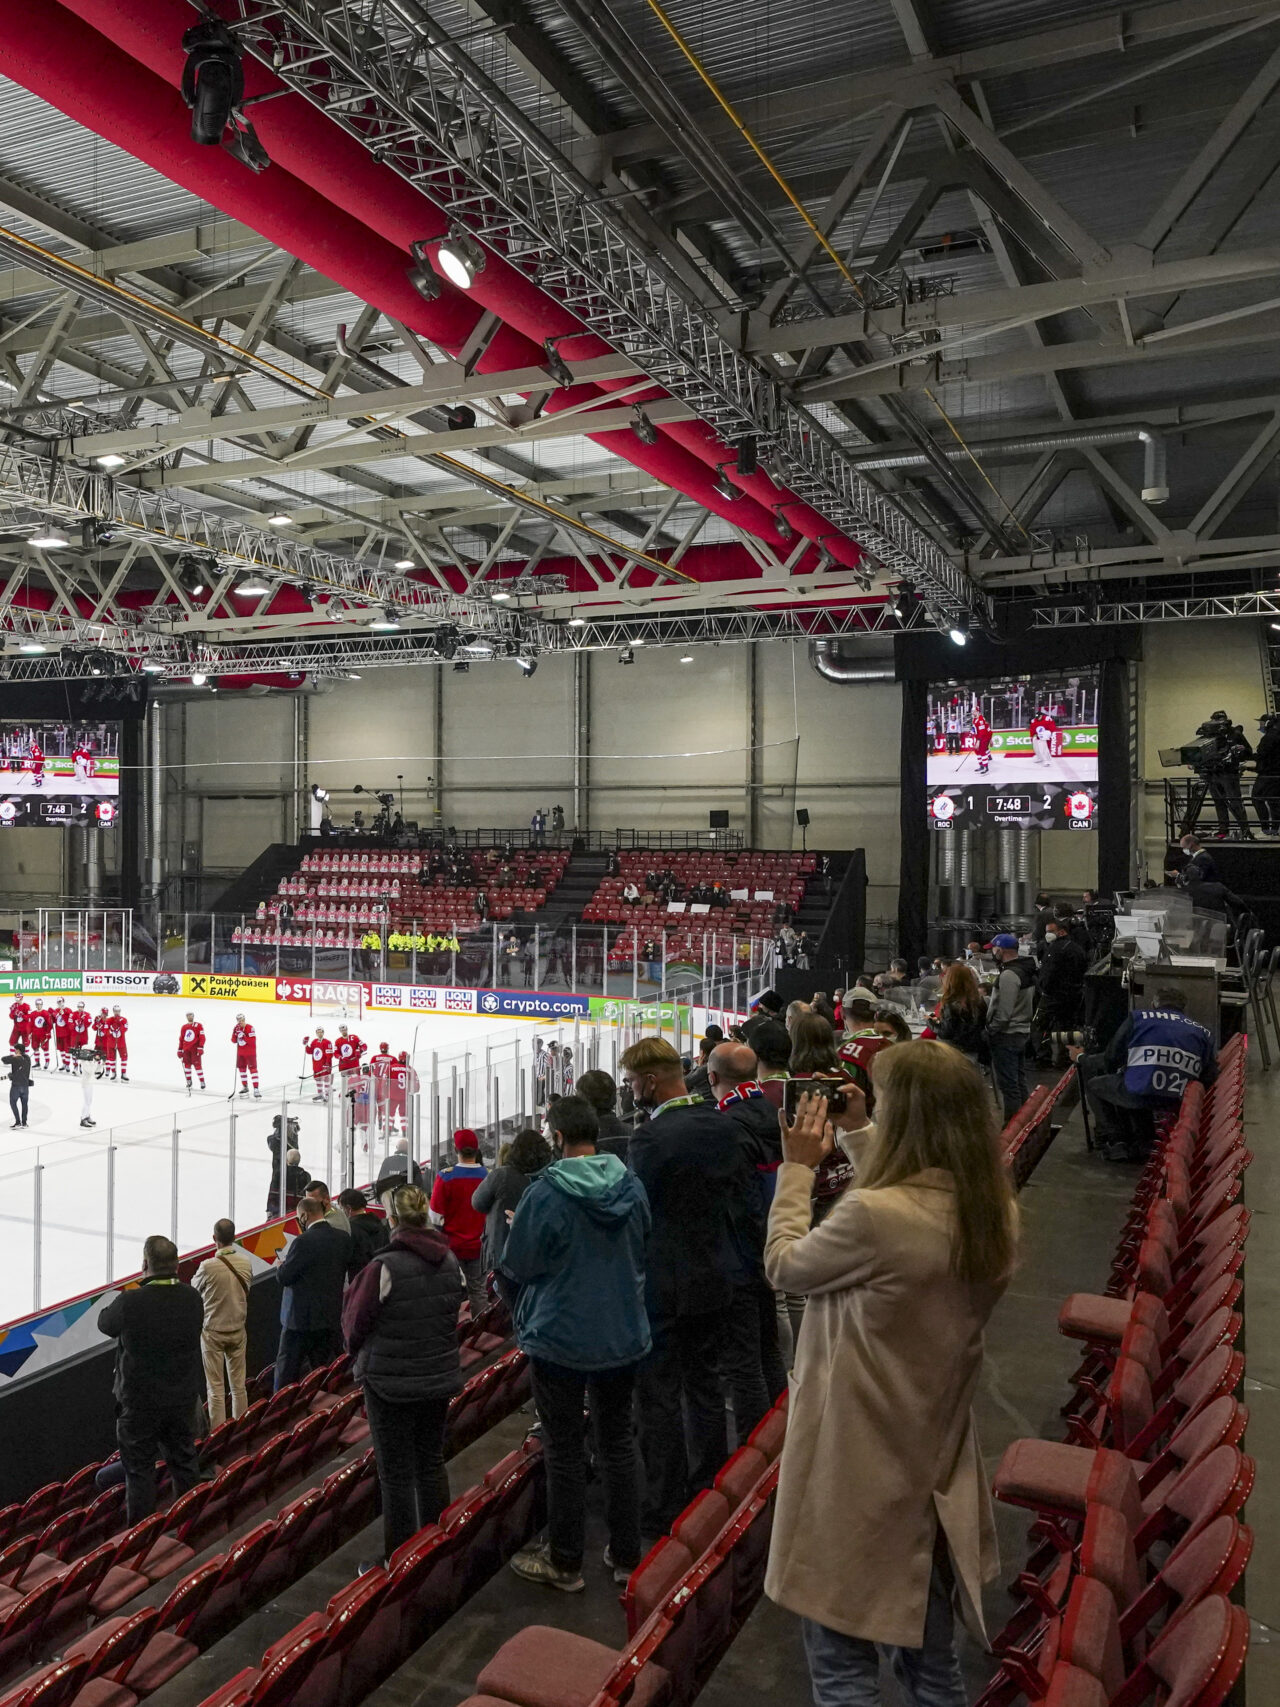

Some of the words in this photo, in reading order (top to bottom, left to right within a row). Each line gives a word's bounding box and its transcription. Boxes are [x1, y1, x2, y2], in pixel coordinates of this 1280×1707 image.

[968, 796, 974, 810] 1
[995, 798, 1022, 811] 7:48
[1043, 795, 1051, 810] 2
[26, 803, 31, 813] 1
[47, 805, 66, 813] 7:48
[81, 803, 87, 814] 2
[994, 815, 1022, 823] Overtime
[1072, 820, 1089, 828] CAN
[104, 975, 150, 985] TISSOT
[209, 976, 269, 989] Райффайзен
[209, 986, 238, 998] БАНК
[293, 984, 370, 1003] STRAUSS
[376, 987, 402, 997] LIQUI
[410, 989, 436, 999] LIQUI
[445, 991, 472, 1001] LIQUI
[376, 996, 402, 1006] MOLY
[410, 998, 436, 1008] MOLY
[445, 1000, 472, 1010] MOLY
[503, 997, 583, 1014] crypto.com
[1142, 1011, 1211, 1037] IIHF.com
[843, 1042, 864, 1058] 91
[1144, 1048, 1201, 1074] PHOTO
